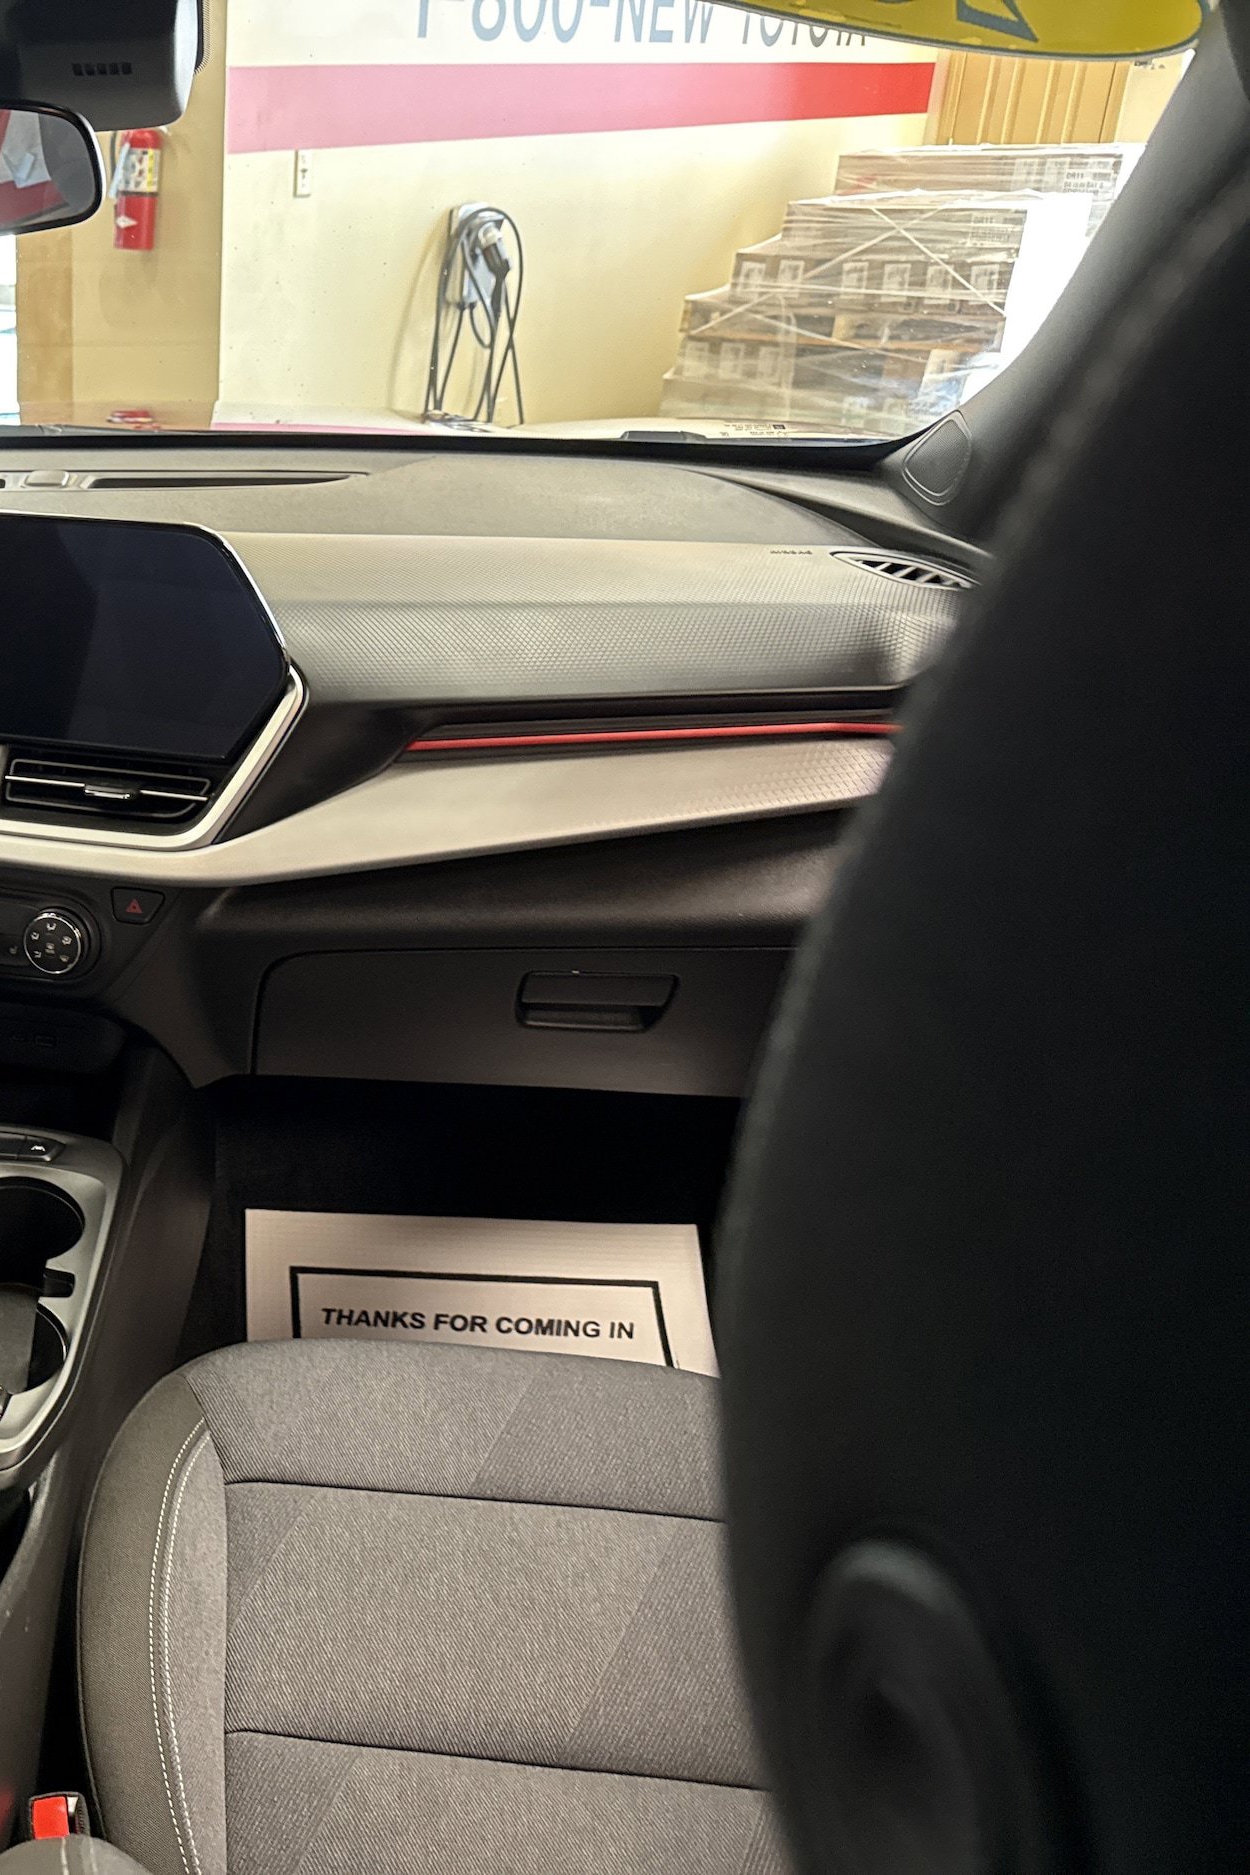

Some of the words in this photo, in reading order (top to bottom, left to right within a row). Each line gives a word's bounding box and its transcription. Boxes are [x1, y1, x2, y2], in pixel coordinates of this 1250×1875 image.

[320, 1307, 426, 1330] THANKS
[432, 1312, 488, 1333] FOR
[495, 1316, 601, 1338] COMING
[608, 1321, 635, 1340] IN
